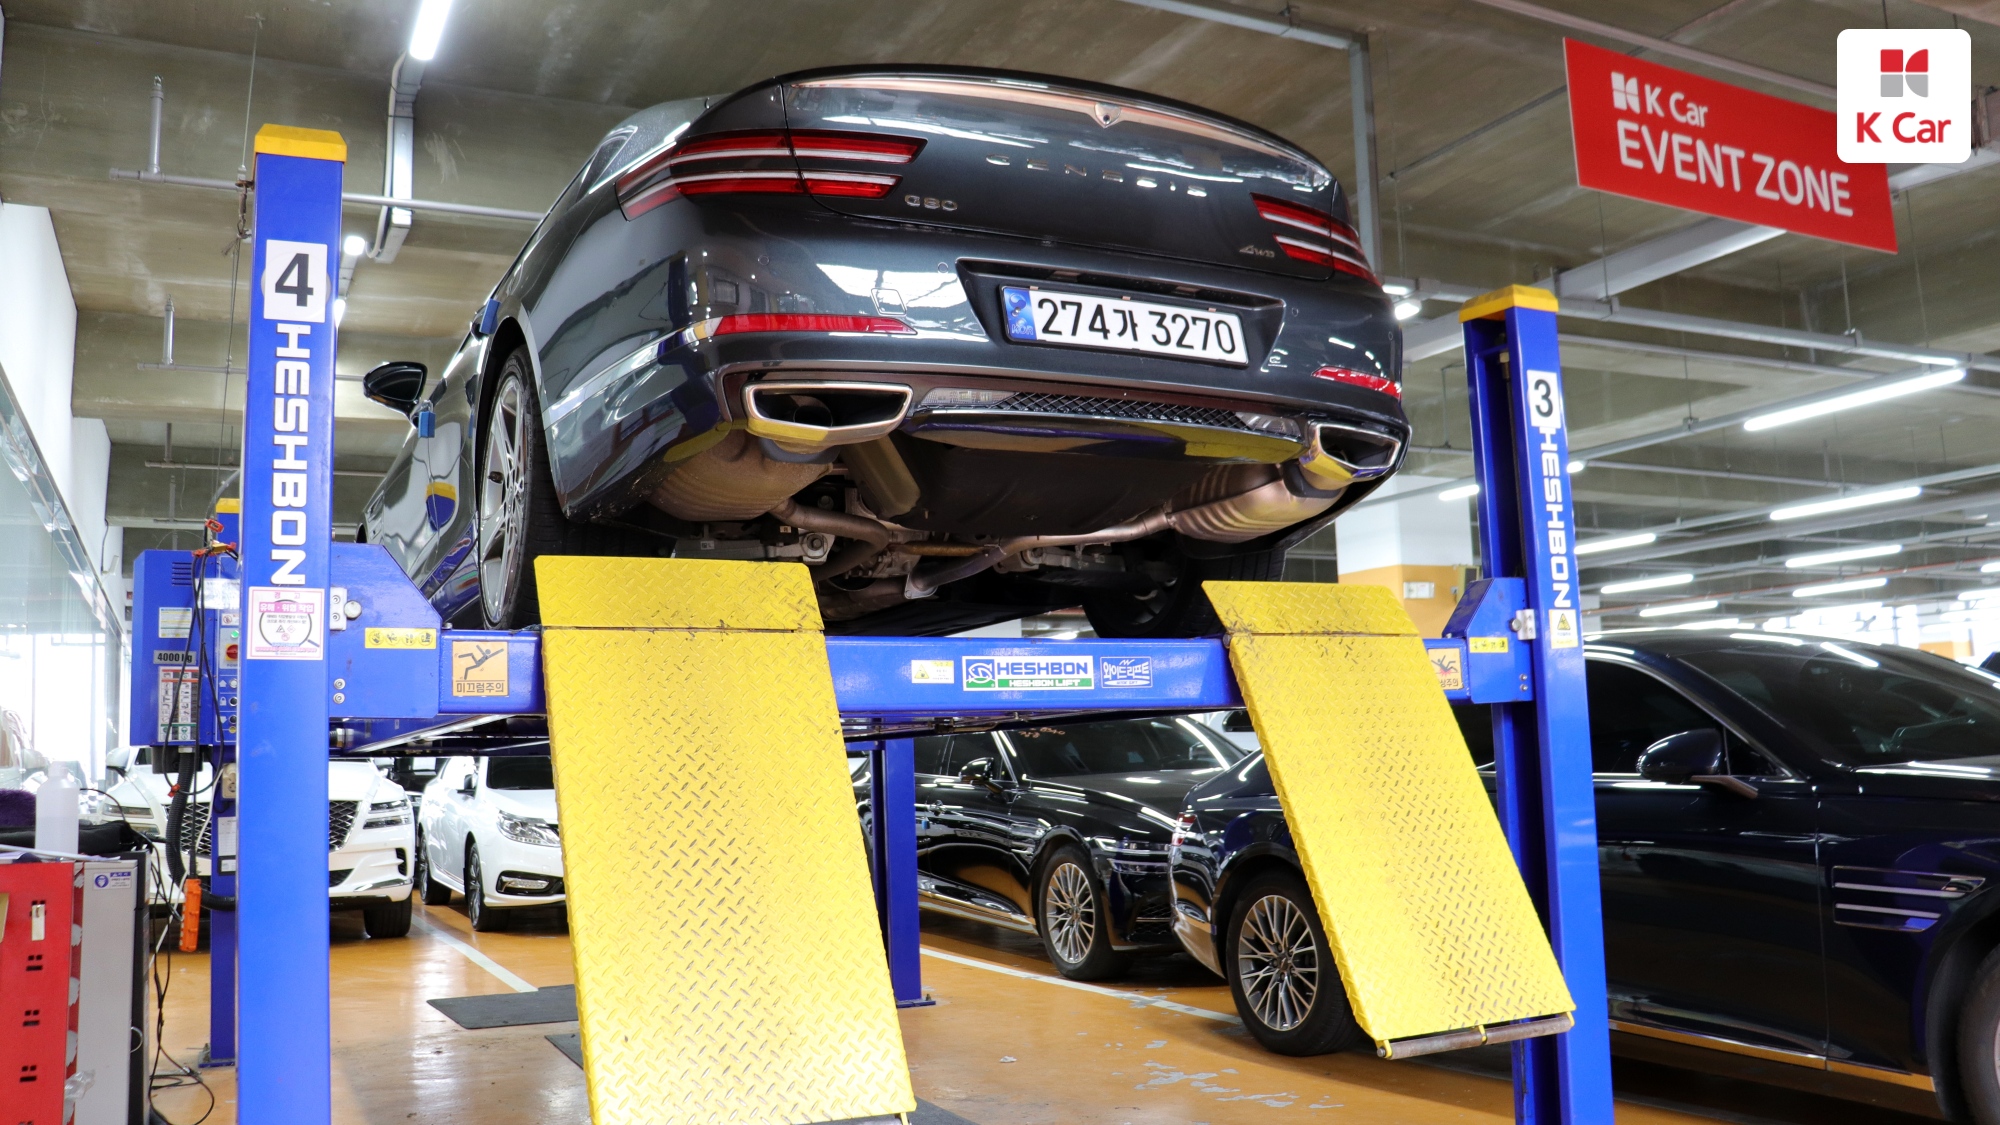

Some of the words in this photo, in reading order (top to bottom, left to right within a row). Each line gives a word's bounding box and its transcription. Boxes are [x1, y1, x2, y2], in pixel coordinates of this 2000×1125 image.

[1644, 83, 1666, 118] K
[1669, 91, 1708, 128] Car
[1616, 120, 1746, 192] EVENT
[1752, 153, 1854, 217] ZONE
[904, 194, 958, 211] G80
[275, 252, 314, 307] 4
[1038, 298, 1139, 342] 274가
[1148, 309, 1236, 354] 3270
[1534, 378, 1554, 418] 3
[270, 322, 311, 585] HESHBON
[1539, 426, 1572, 608] HESHBON
[157, 652, 180, 662] 4000
[997, 662, 1088, 675] HESHBON
[456, 682, 504, 693] 미끄럼주의
[1009, 679, 1054, 687] HESHBON
[1055, 679, 1081, 687] LIFT
[1439, 678, 1459, 688] 상주의
